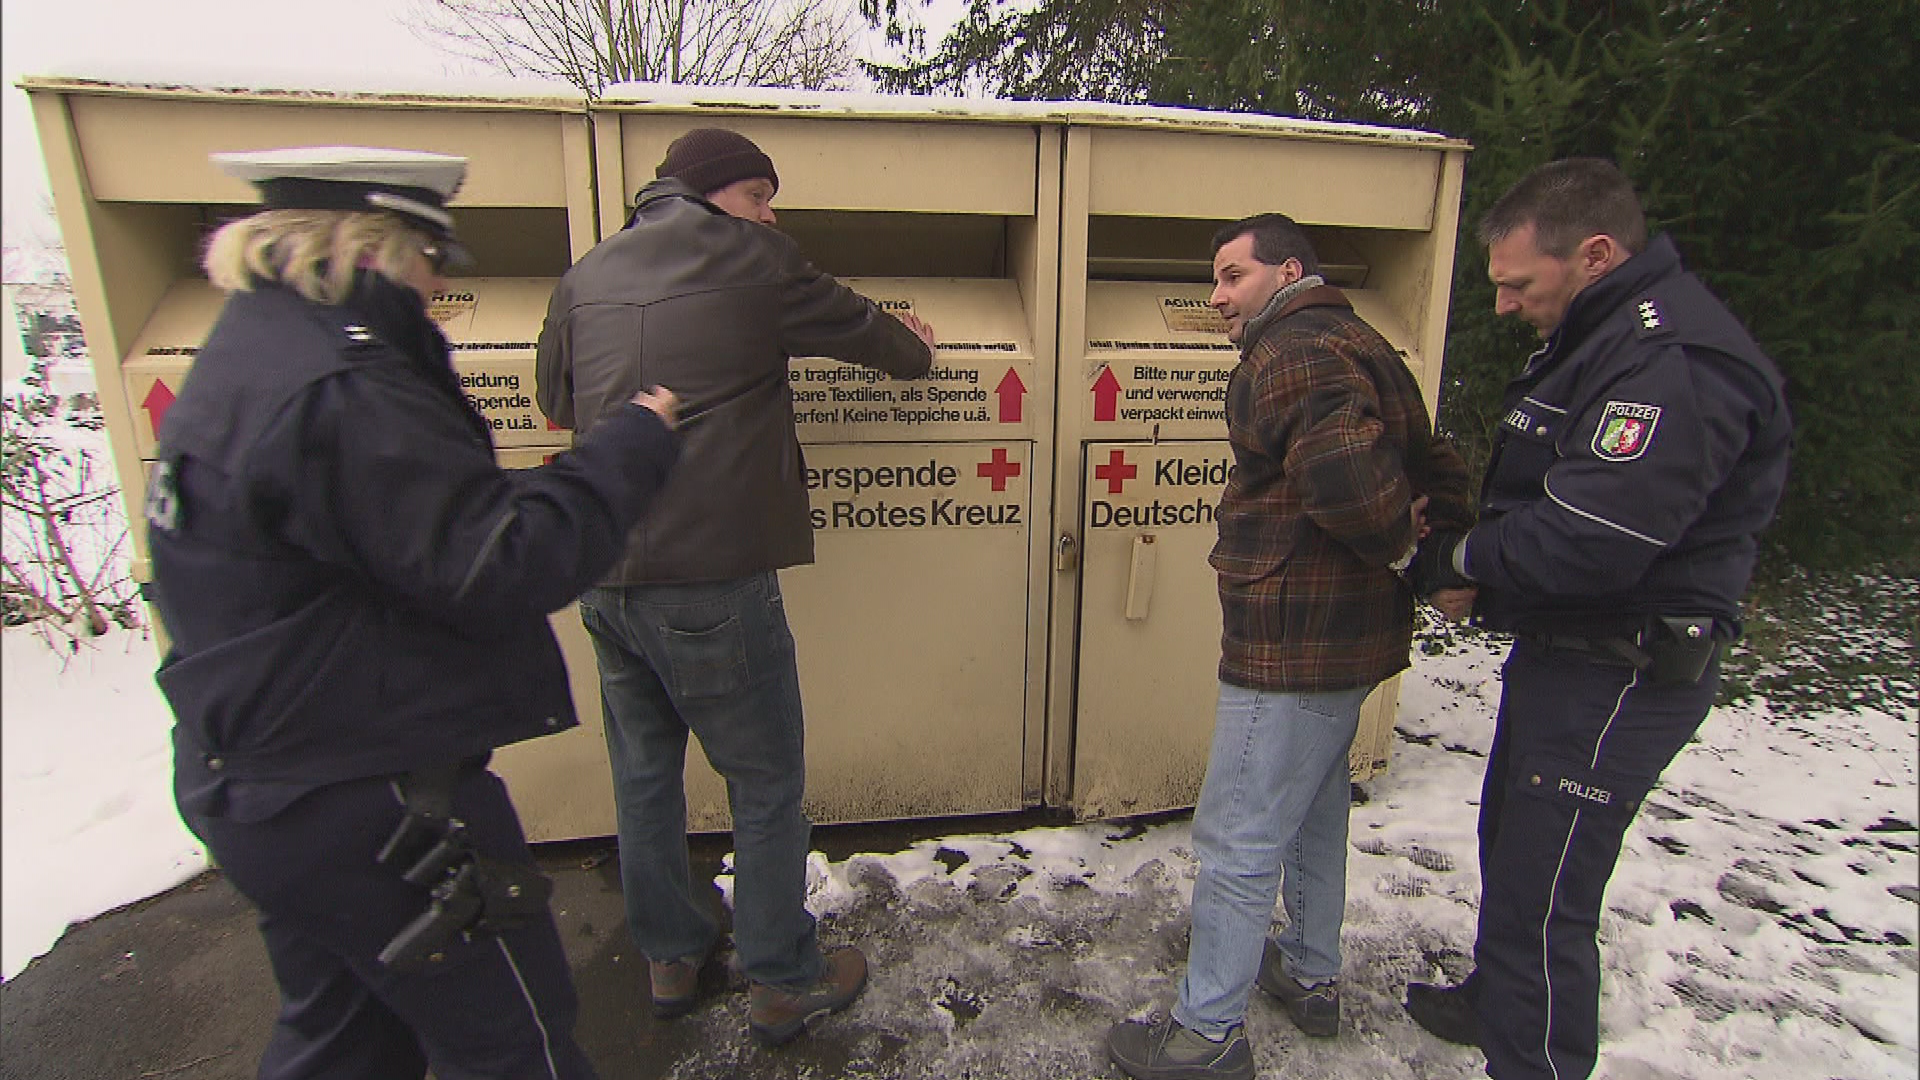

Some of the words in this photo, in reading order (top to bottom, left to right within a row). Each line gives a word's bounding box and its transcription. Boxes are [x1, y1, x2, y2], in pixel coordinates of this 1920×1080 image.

[456, 372, 520, 390] leidung
[1133, 366, 1167, 381] Bitte
[1170, 370, 1195, 382] nur
[828, 386, 897, 404] Textilien,
[900, 387, 924, 402] als
[927, 387, 987, 406] Spende
[1125, 387, 1153, 400] und
[1156, 387, 1228, 402] verwendb
[794, 408, 839, 424] erfen!
[842, 408, 889, 425] Keine
[889, 407, 961, 426] Teppiche
[963, 406, 991, 424] u.ä.
[1120, 407, 1184, 424] verpackt
[1608, 404, 1657, 420] POLIZEI
[506, 414, 537, 430] u.ä.
[807, 458, 957, 495] erspende
[832, 500, 926, 529] Rotes
[931, 498, 1022, 527] Kreuz
[1558, 778, 1612, 804] POLIZEI
